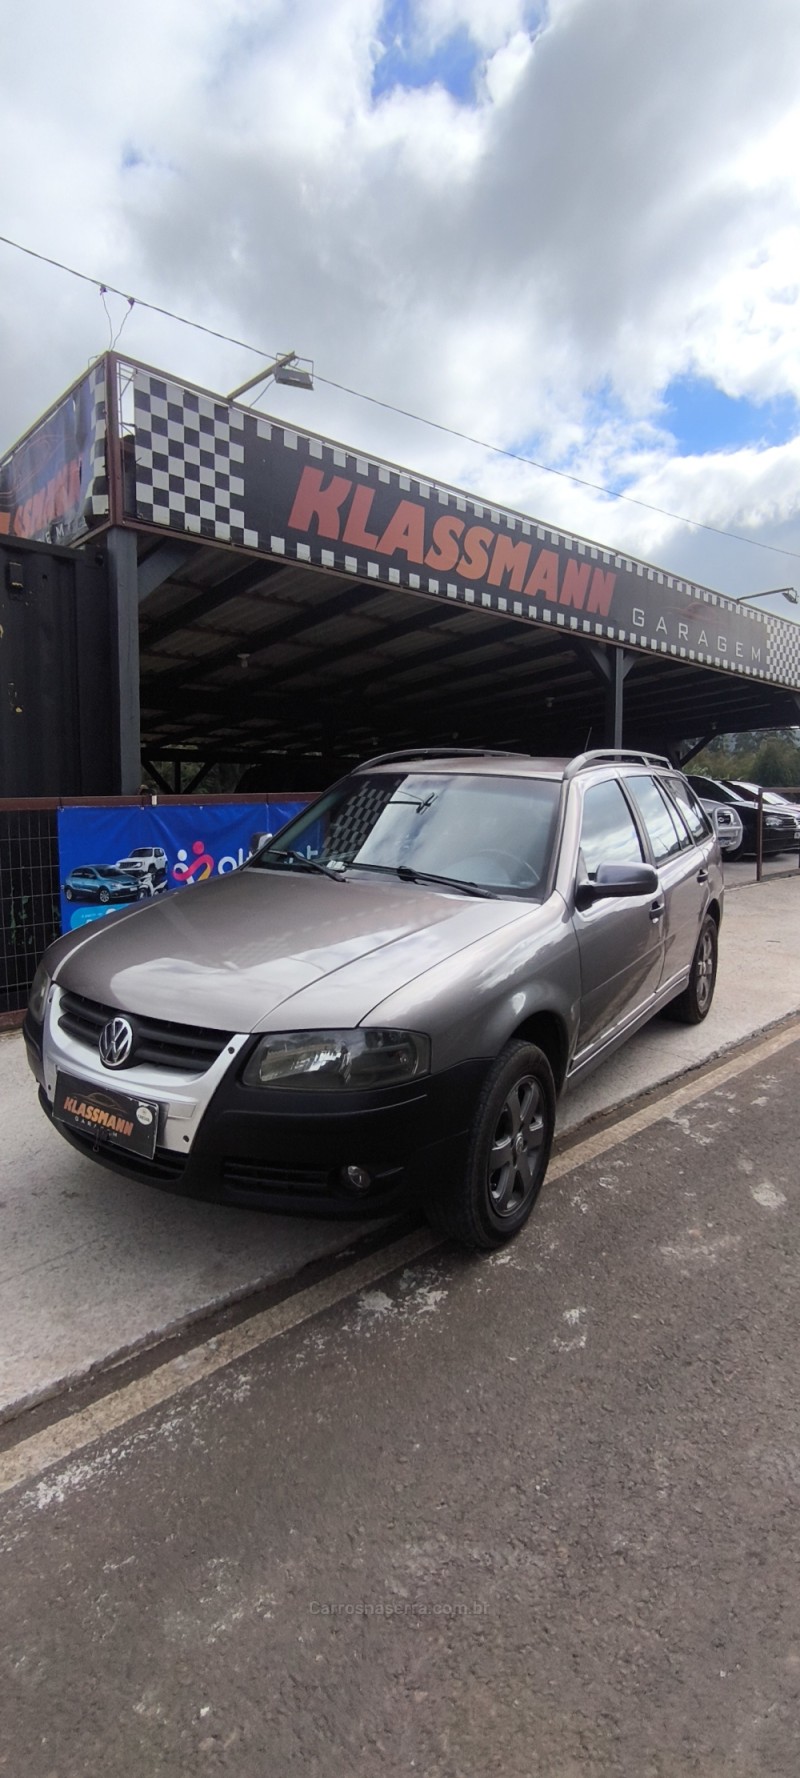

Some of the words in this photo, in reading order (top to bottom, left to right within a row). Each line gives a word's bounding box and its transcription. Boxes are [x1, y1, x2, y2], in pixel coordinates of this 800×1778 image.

[287, 465, 617, 617] KLASSMANN
[632, 607, 761, 663] GARAGEM
[63, 1096, 134, 1137] KLASSMANN
